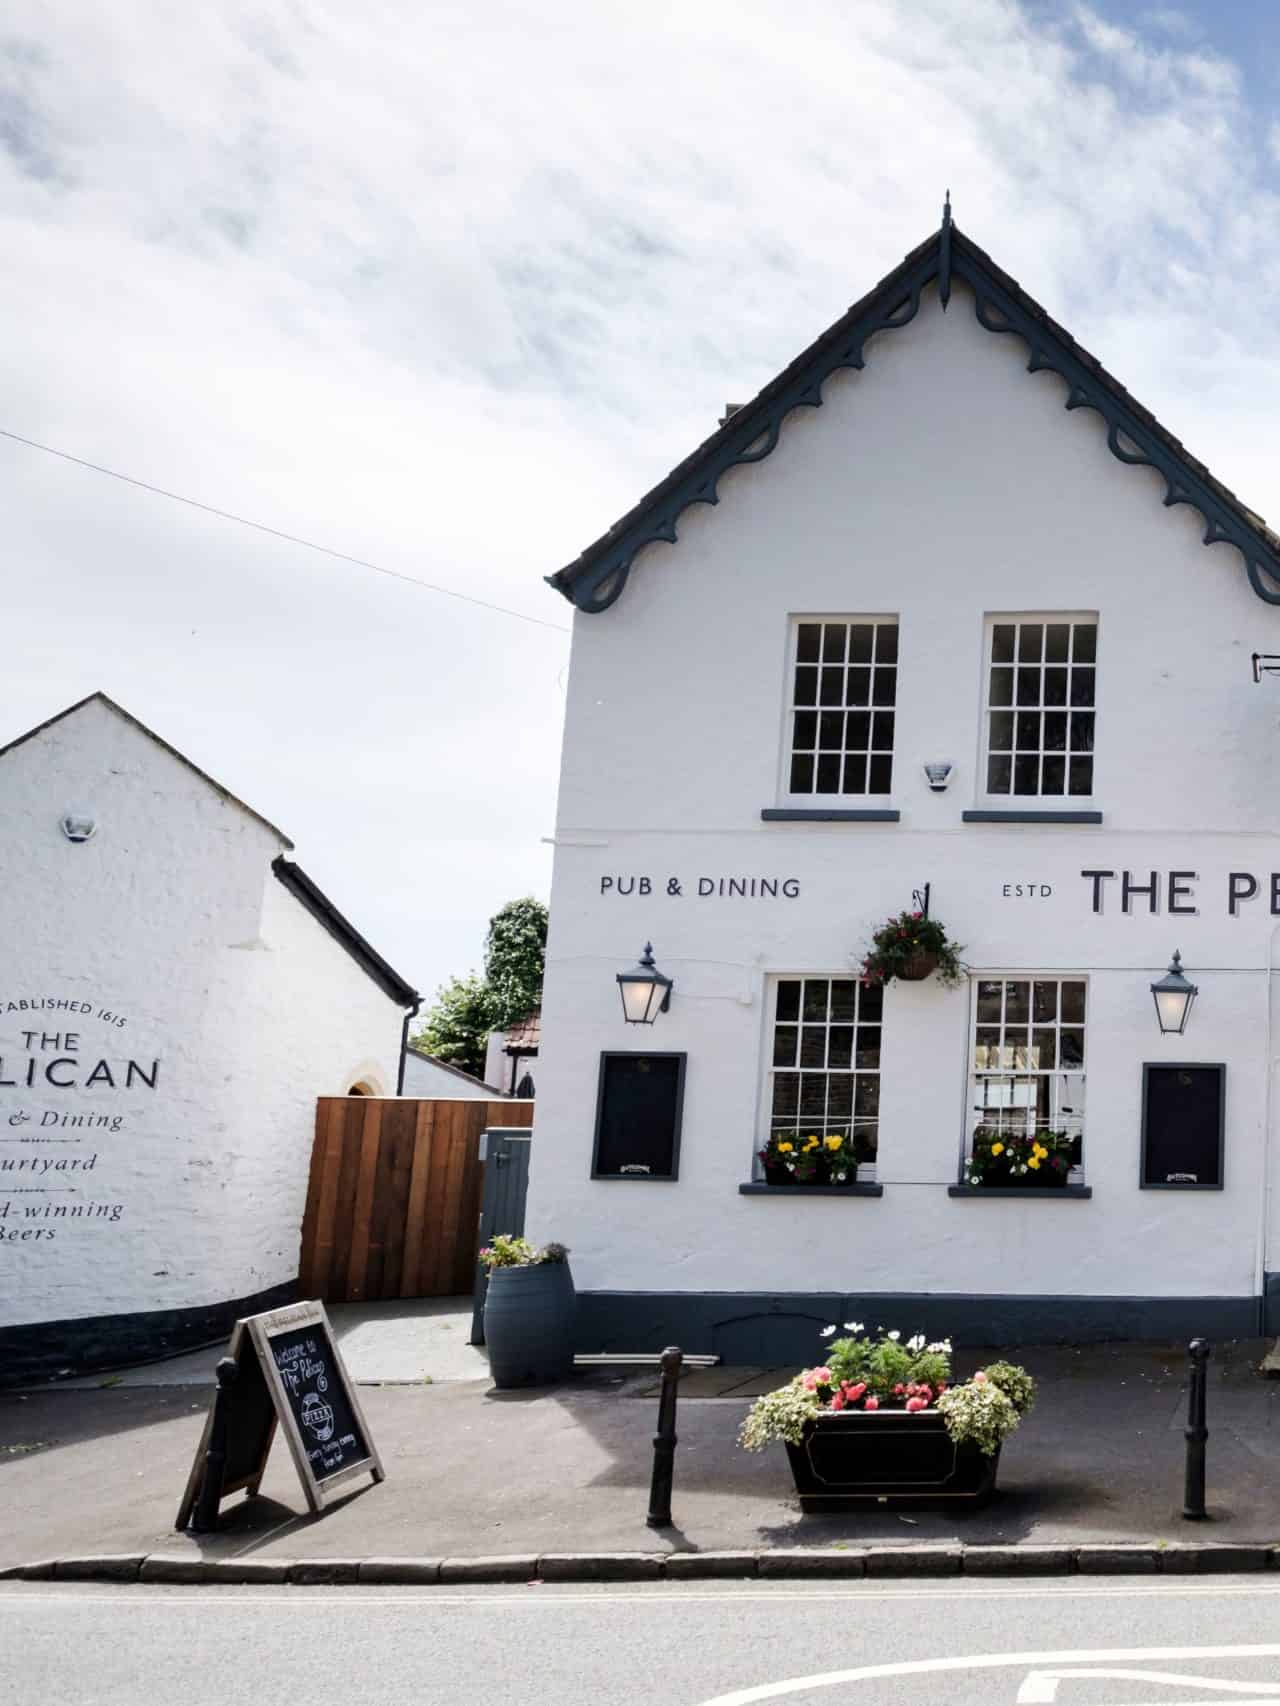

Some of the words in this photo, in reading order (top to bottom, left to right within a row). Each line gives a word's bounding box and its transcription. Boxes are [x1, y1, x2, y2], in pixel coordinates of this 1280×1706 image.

[601, 876, 652, 896] PUB
[666, 876, 682, 897] &
[698, 877, 801, 899] DINING
[1002, 884, 1053, 899] ESTD
[1081, 870, 1200, 915] THE
[0, 999, 93, 1015] ABLISHED
[97, 1009, 128, 1028] 1615
[21, 1031, 80, 1051] THE
[8, 1110, 31, 1127] &
[40, 1111, 124, 1133] Dining
[304, 1409, 331, 1425] PIZZA
